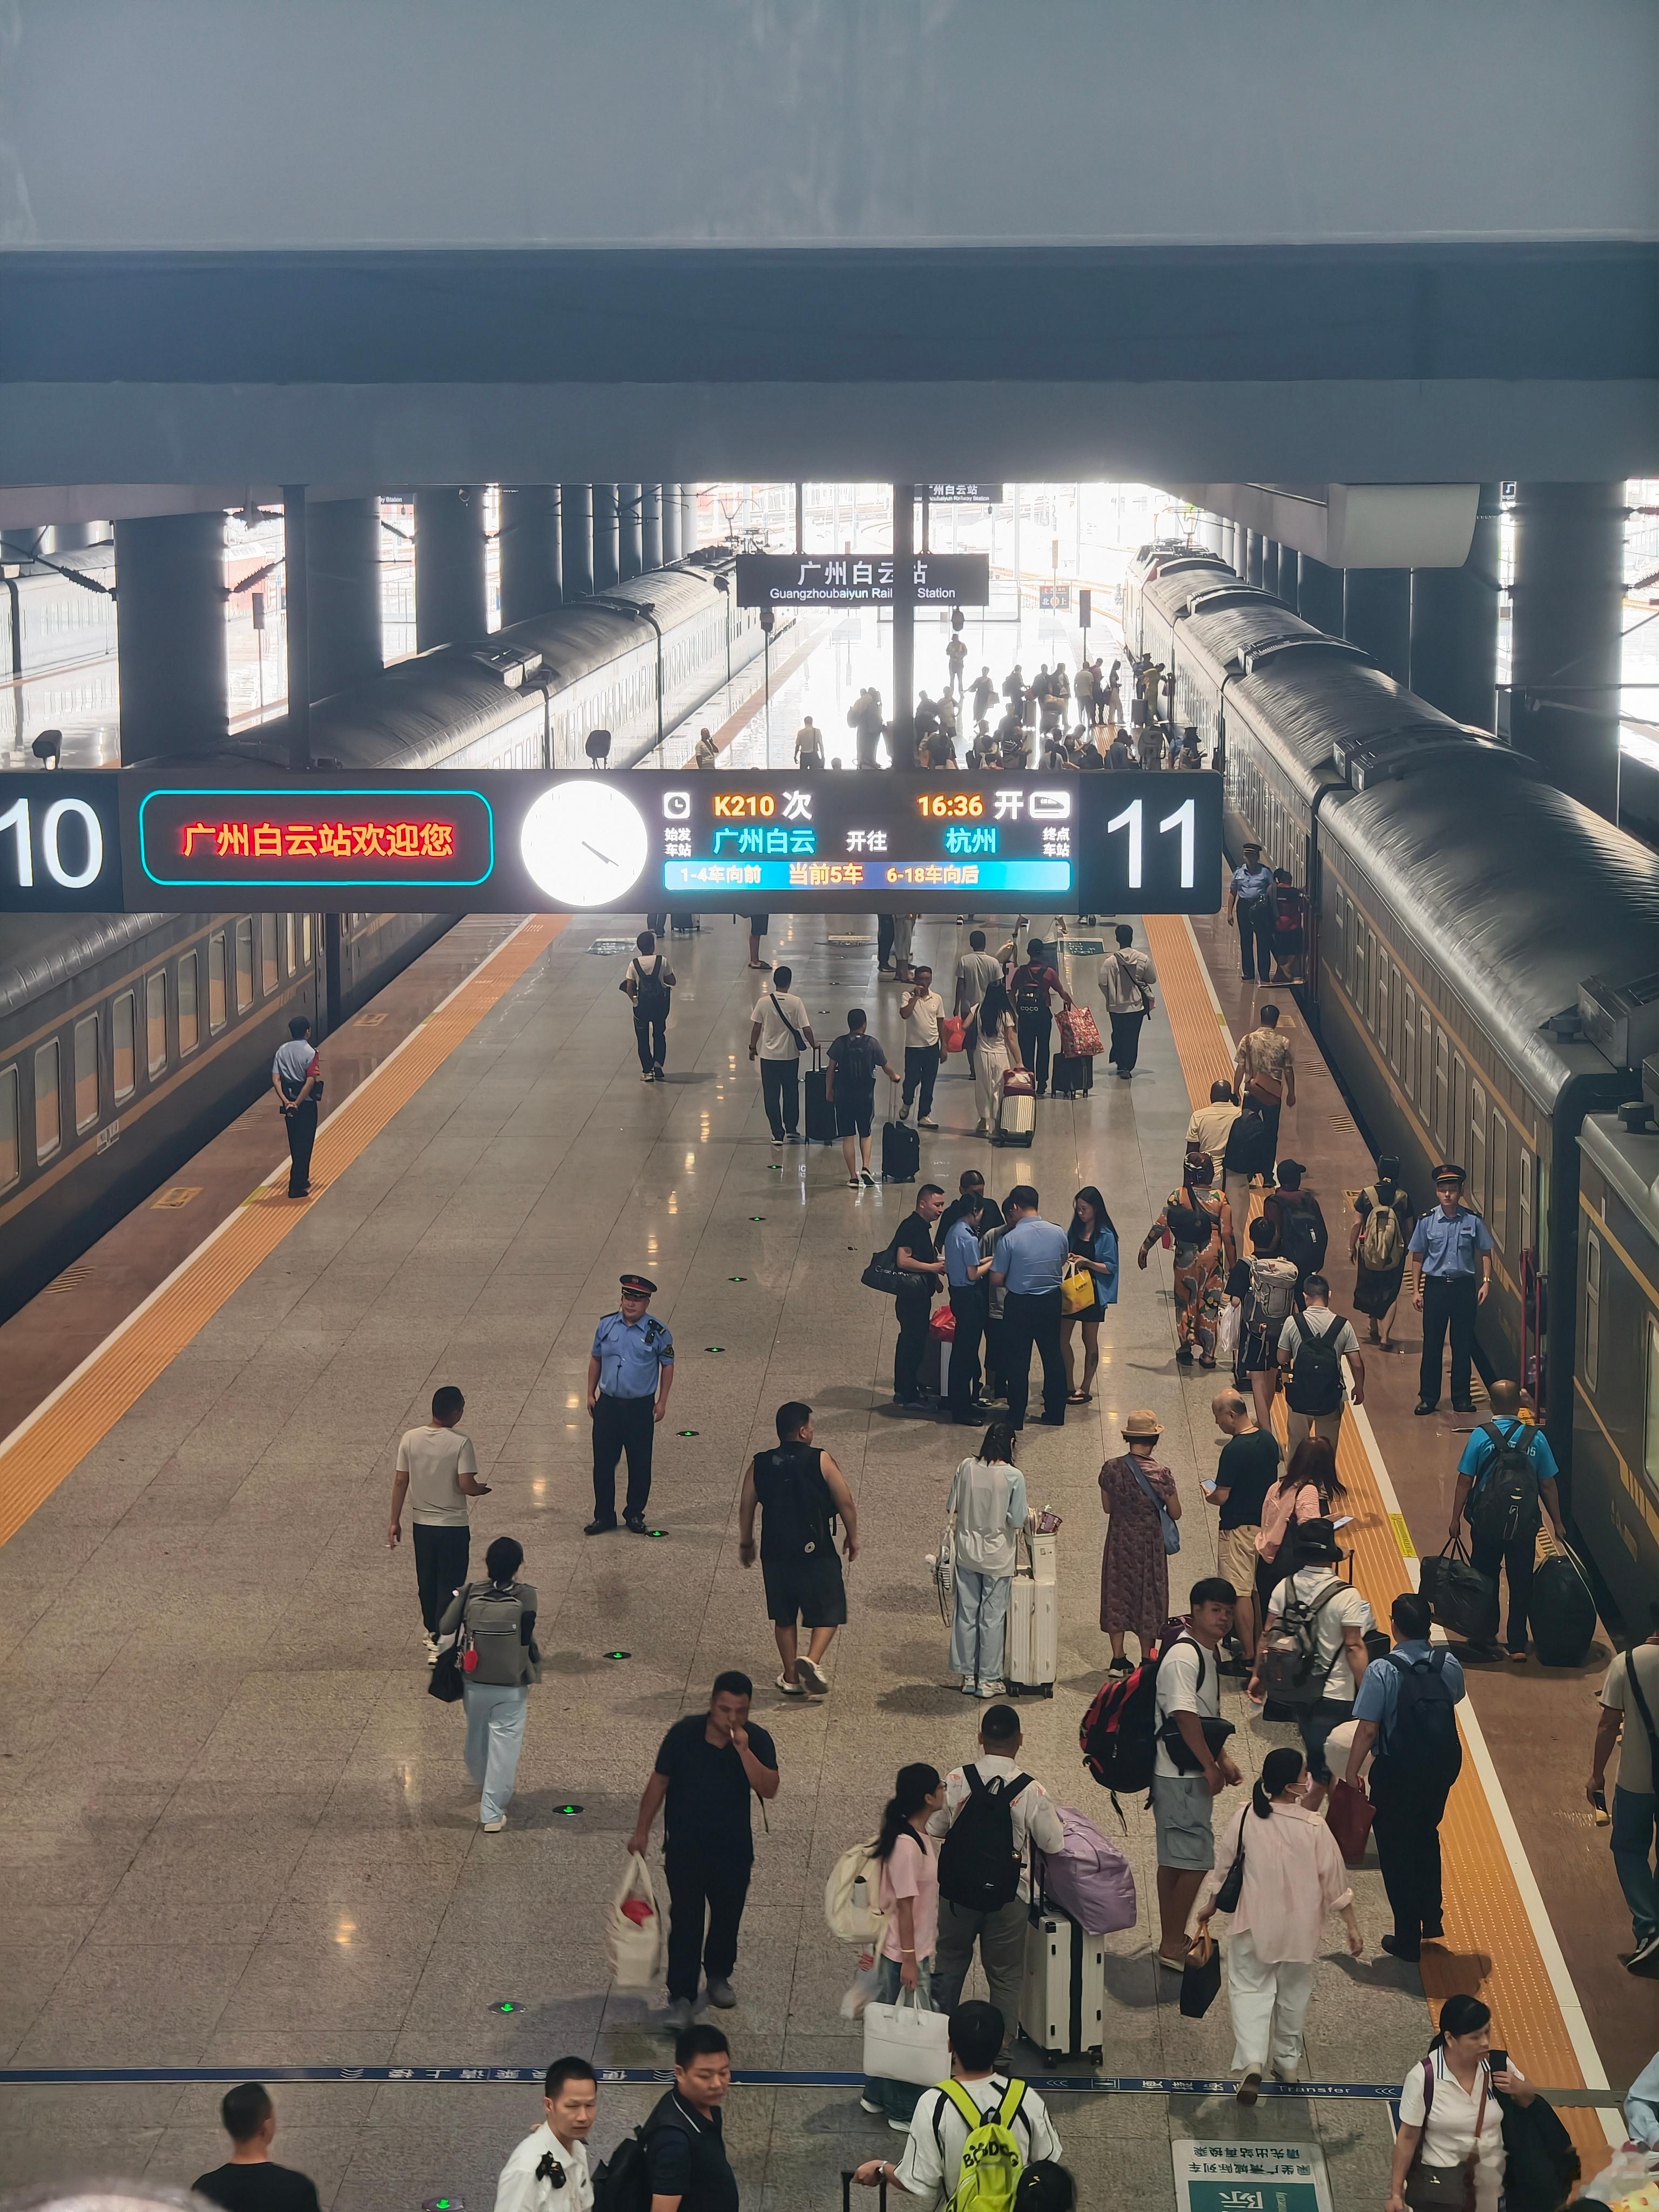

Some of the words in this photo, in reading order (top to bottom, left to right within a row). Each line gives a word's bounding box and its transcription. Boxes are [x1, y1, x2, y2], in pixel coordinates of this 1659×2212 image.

[929, 484, 978, 495] 州白云站
[770, 588, 868, 601] Guangzhoubaiyun
[872, 588, 893, 598] Rail
[918, 588, 955, 598] Station
[713, 795, 775, 817] K210
[782, 791, 812, 819] 次
[918, 794, 983, 817] 16:36
[994, 791, 1024, 820] 开
[0, 798, 103, 888] 10
[184, 823, 453, 858] 广州白云站欢迎您
[664, 827, 691, 841] 始发
[713, 827, 815, 854] 广州白云
[846, 830, 888, 852] 开往
[945, 827, 996, 854] 杭州
[1042, 827, 1070, 841] 终点
[664, 843, 691, 857] 车站
[1042, 843, 1070, 857] 车站
[1108, 799, 1195, 888] 11
[680, 866, 761, 884] 1-4车向前
[789, 863, 864, 885] 当前5车
[887, 865, 980, 884] 6-18车向后
[1274, 2085, 1352, 2093] Transfer
